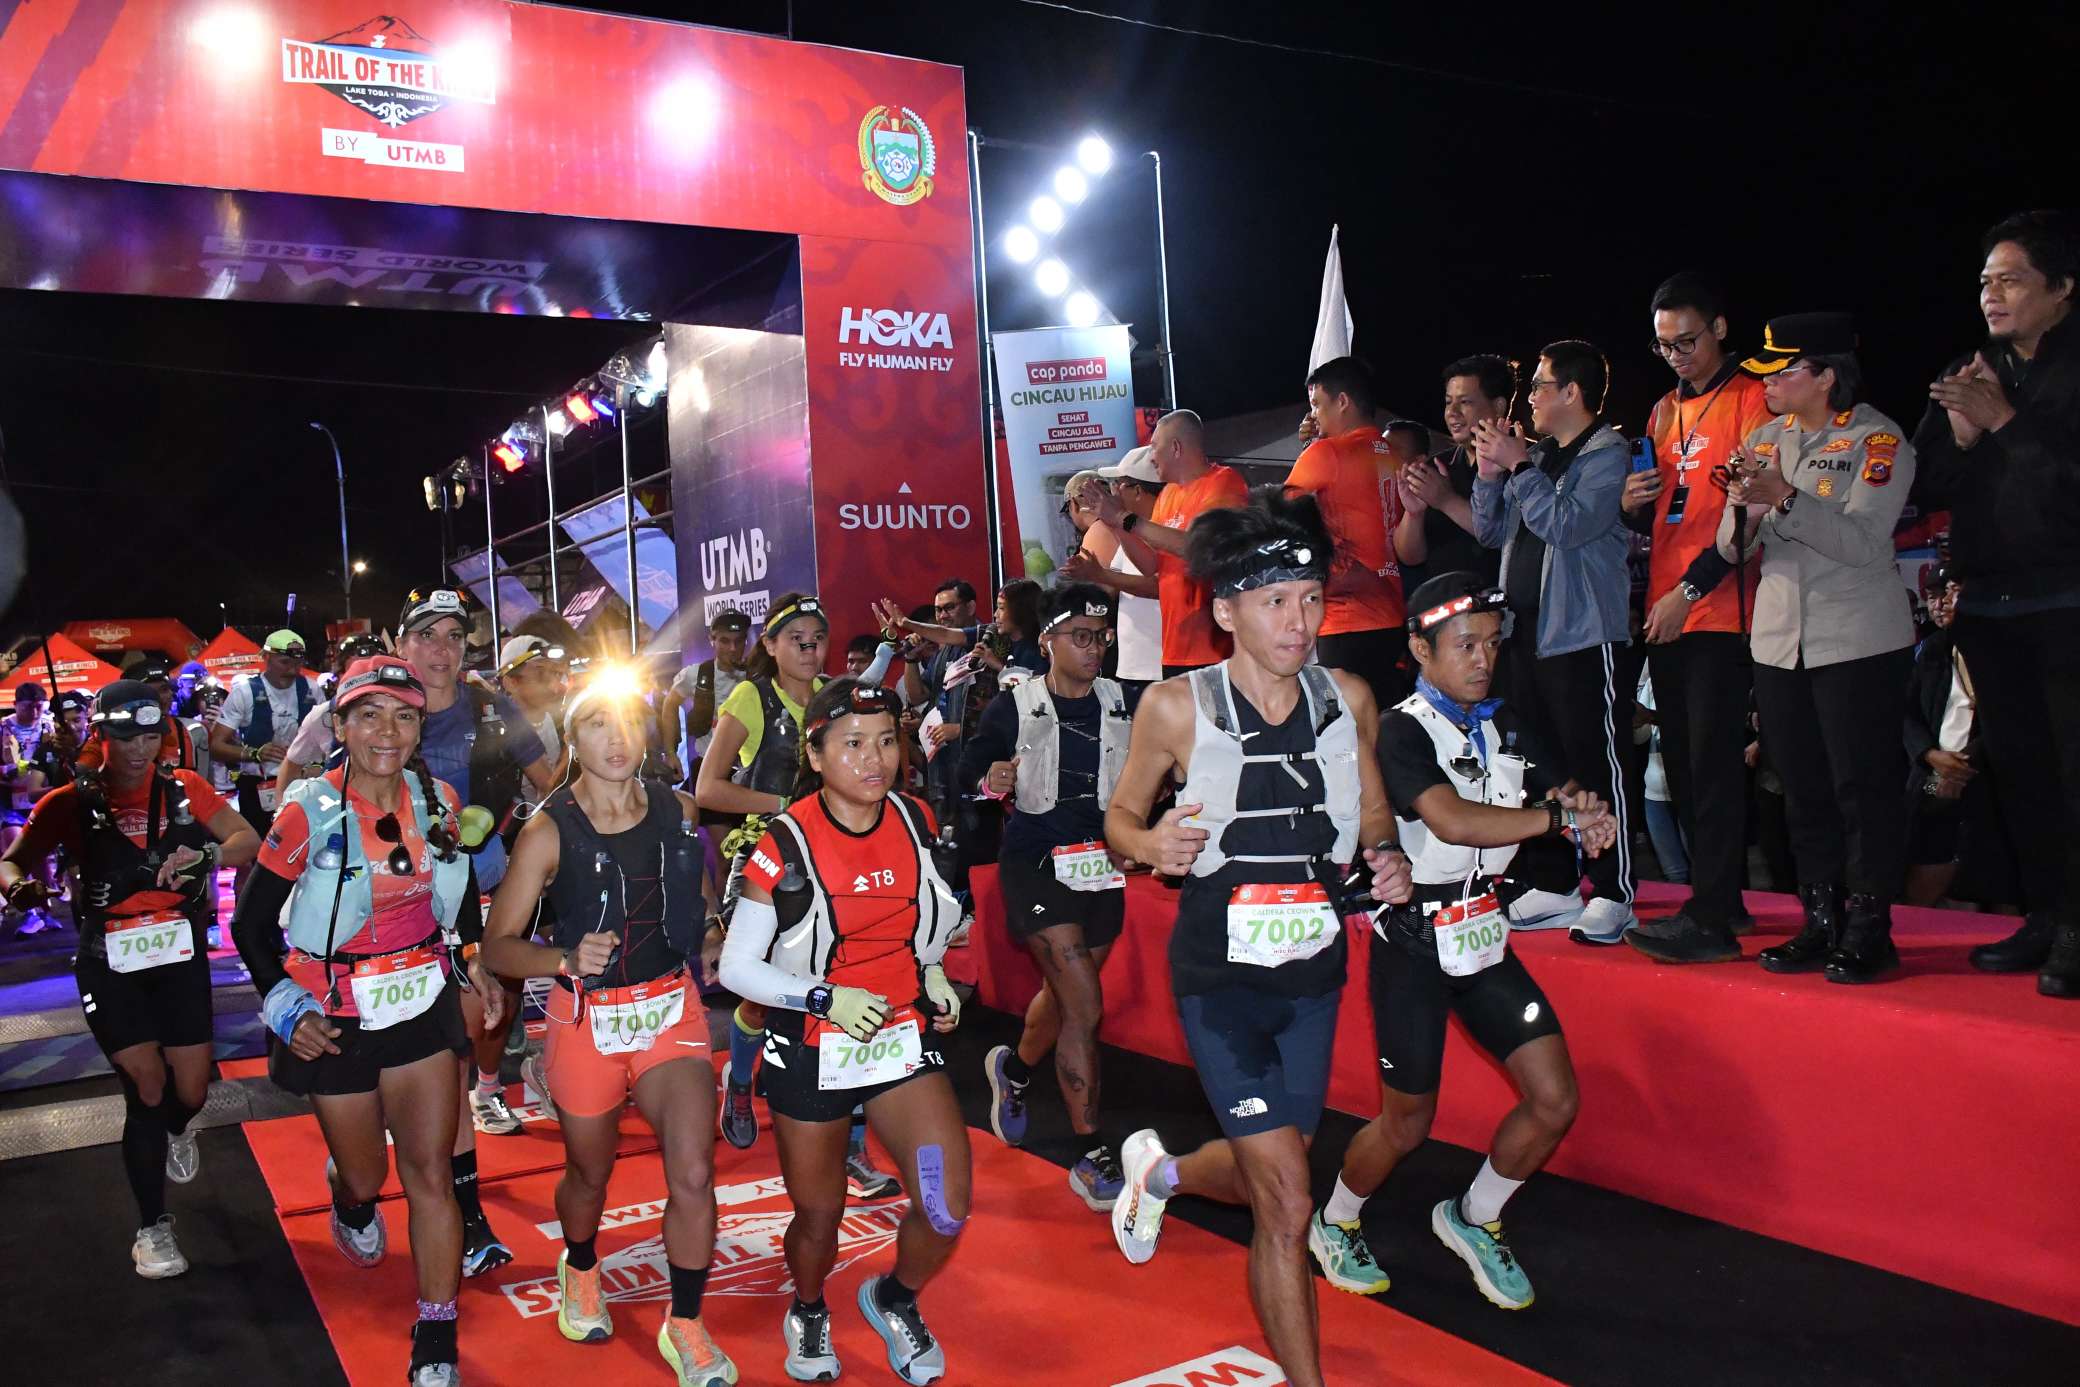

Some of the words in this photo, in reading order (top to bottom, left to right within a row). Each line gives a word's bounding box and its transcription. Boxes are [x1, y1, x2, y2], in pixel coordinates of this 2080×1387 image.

[286, 43, 348, 81] TRAIL
[355, 57, 380, 82] OF
[387, 62, 426, 88] THE
[345, 86, 366, 96] LAKE
[367, 88, 389, 98] TOBA
[396, 91, 439, 103] INDONESIA
[335, 135, 358, 151] BY
[387, 144, 446, 165] UTMB
[377, 254, 528, 276] WORLD
[838, 306, 954, 350] HOKA
[840, 352, 865, 368] FLY
[867, 353, 928, 371] HUMAN
[930, 356, 955, 372] FLY
[1030, 366, 1056, 382] cap
[1060, 362, 1103, 381] panda
[1010, 387, 1076, 407] CINCAU
[1079, 383, 1129, 403] HIJAU
[1061, 413, 1085, 424] SEHAT
[1051, 427, 1081, 438] CINCAU
[1082, 424, 1100, 436] ASLI
[1042, 443, 1068, 454] TANPA
[1068, 439, 1113, 452] PENGAWET
[1807, 459, 1852, 473] POLRI
[839, 503, 971, 530] SUUNTO
[700, 527, 768, 592] UTMB
[739, 597, 769, 618] SERIES
[751, 849, 781, 878] RUN
[1066, 859, 1114, 880] 7020
[870, 869, 895, 889] T8
[1251, 907, 1285, 916] CALDERA
[1286, 907, 1316, 915] CROWN
[1247, 917, 1325, 945] 7002
[1453, 921, 1503, 957] 7003
[120, 930, 178, 957] 7047
[368, 975, 428, 1010] 7067
[837, 1038, 904, 1069] 7006
[923, 1051, 945, 1065] T8
[1230, 1105, 1254, 1115] NORTH
[1237, 1110, 1256, 1118] FACE
[1238, 1099, 1253, 1107] THE
[840, 1202, 909, 1240] RAIL
[1123, 1183, 1140, 1237] TERREX
[710, 1243, 761, 1270] TH
